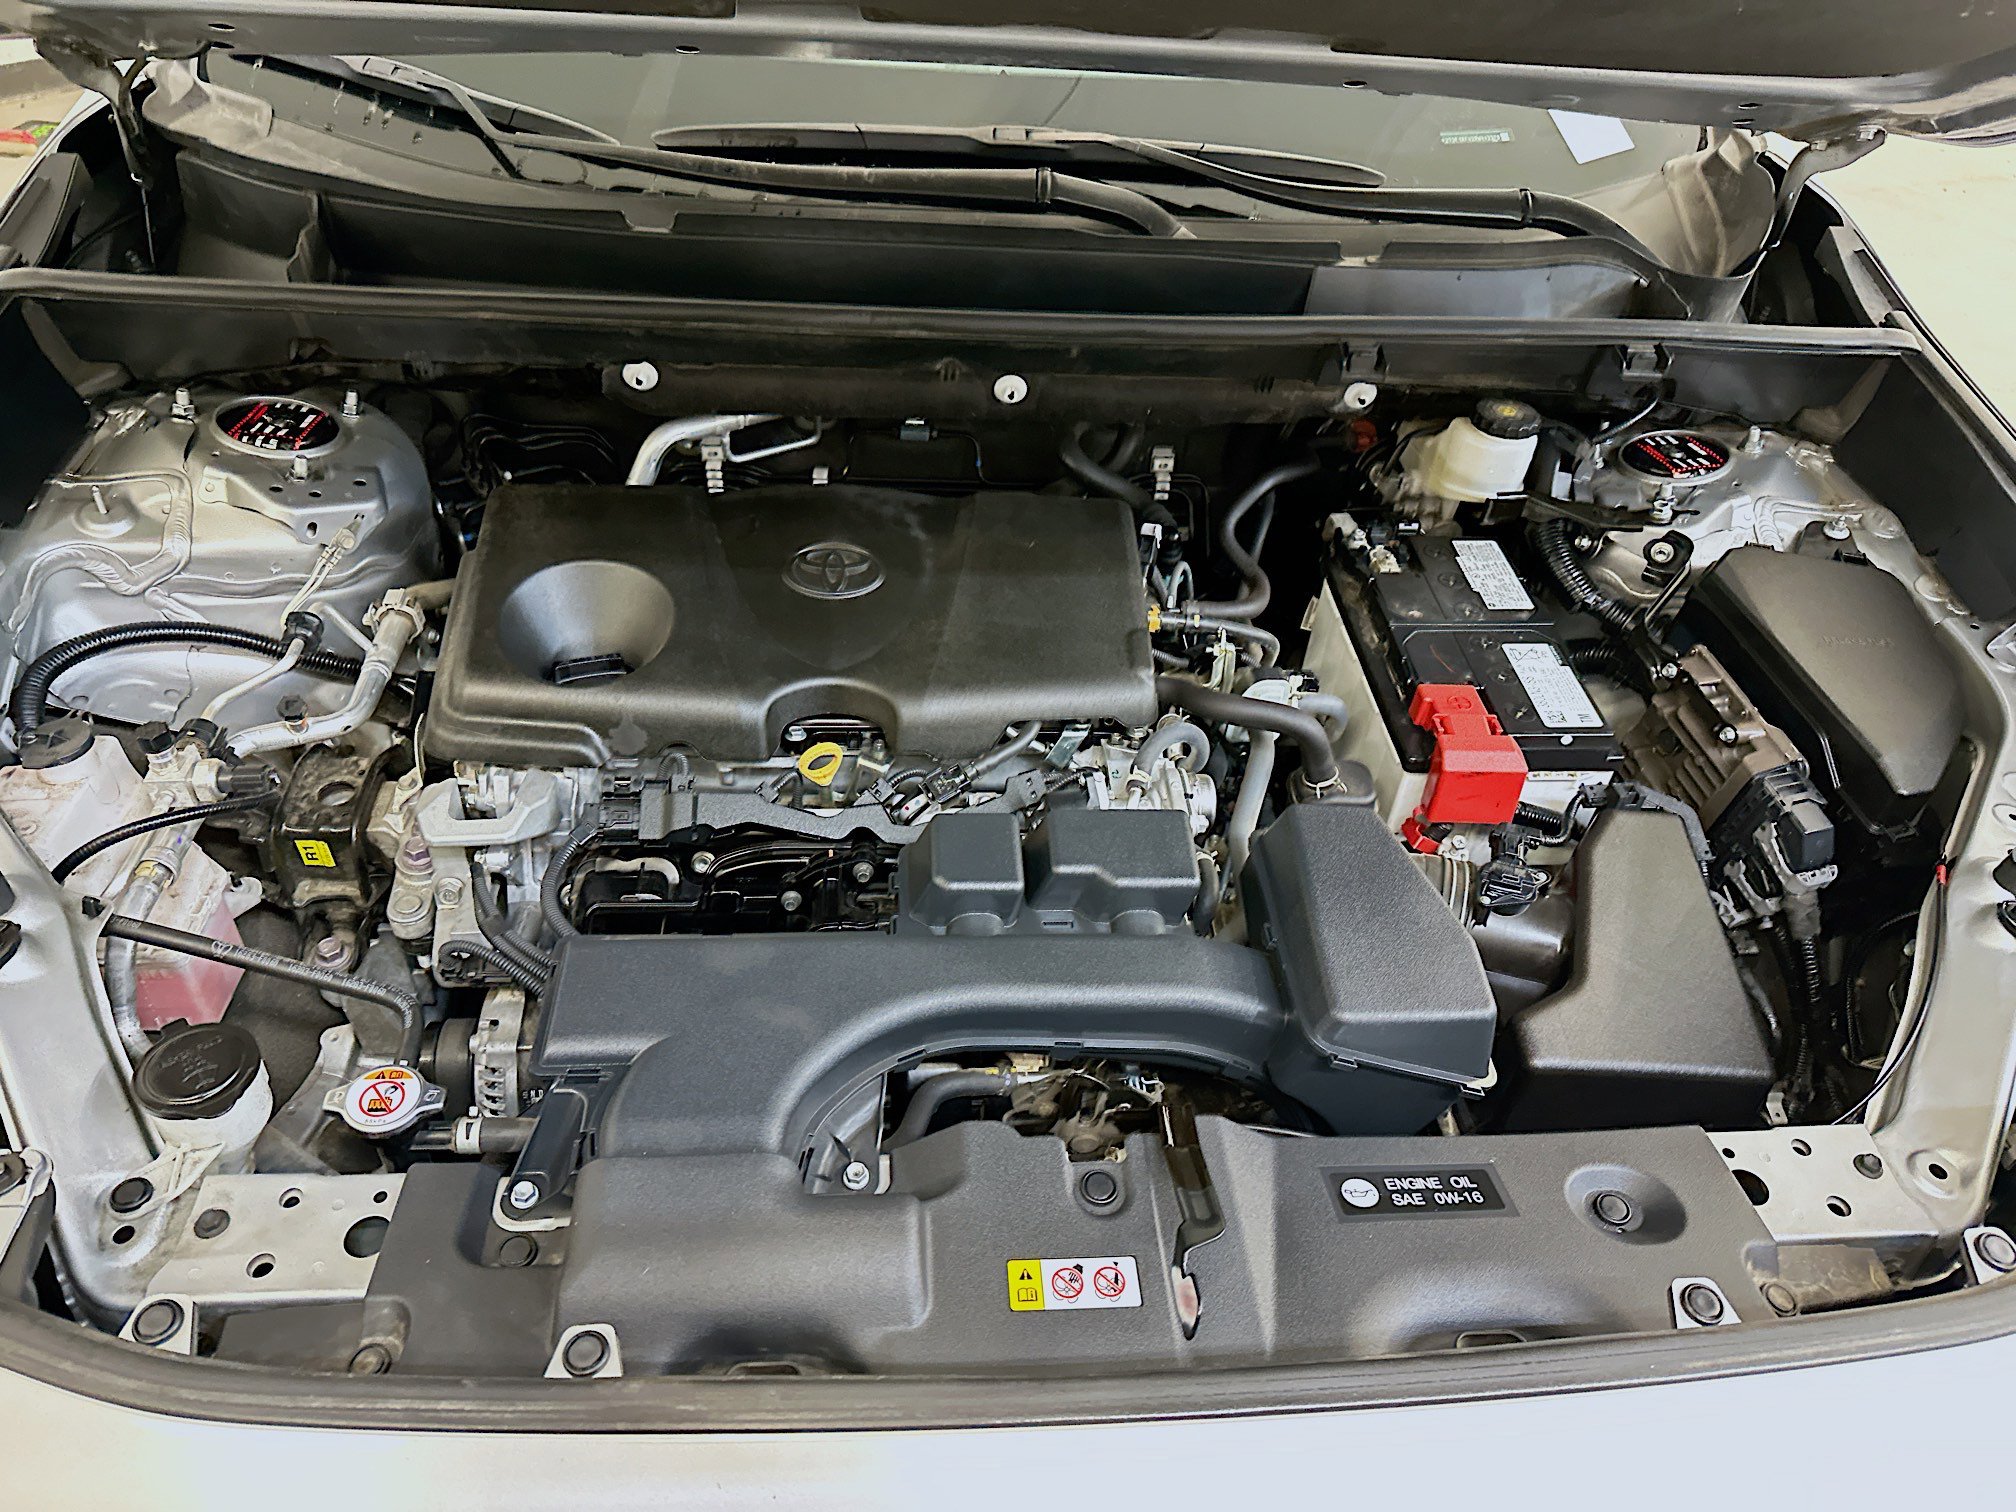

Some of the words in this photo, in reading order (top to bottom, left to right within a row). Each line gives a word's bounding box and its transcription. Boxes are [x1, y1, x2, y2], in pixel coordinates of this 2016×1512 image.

[302, 846, 319, 861] R1
[1384, 1177, 1443, 1191] ENGINE
[1450, 1176, 1478, 1189] OIL
[1392, 1193, 1426, 1206] SAE
[1434, 1191, 1485, 1205] 0W-16
